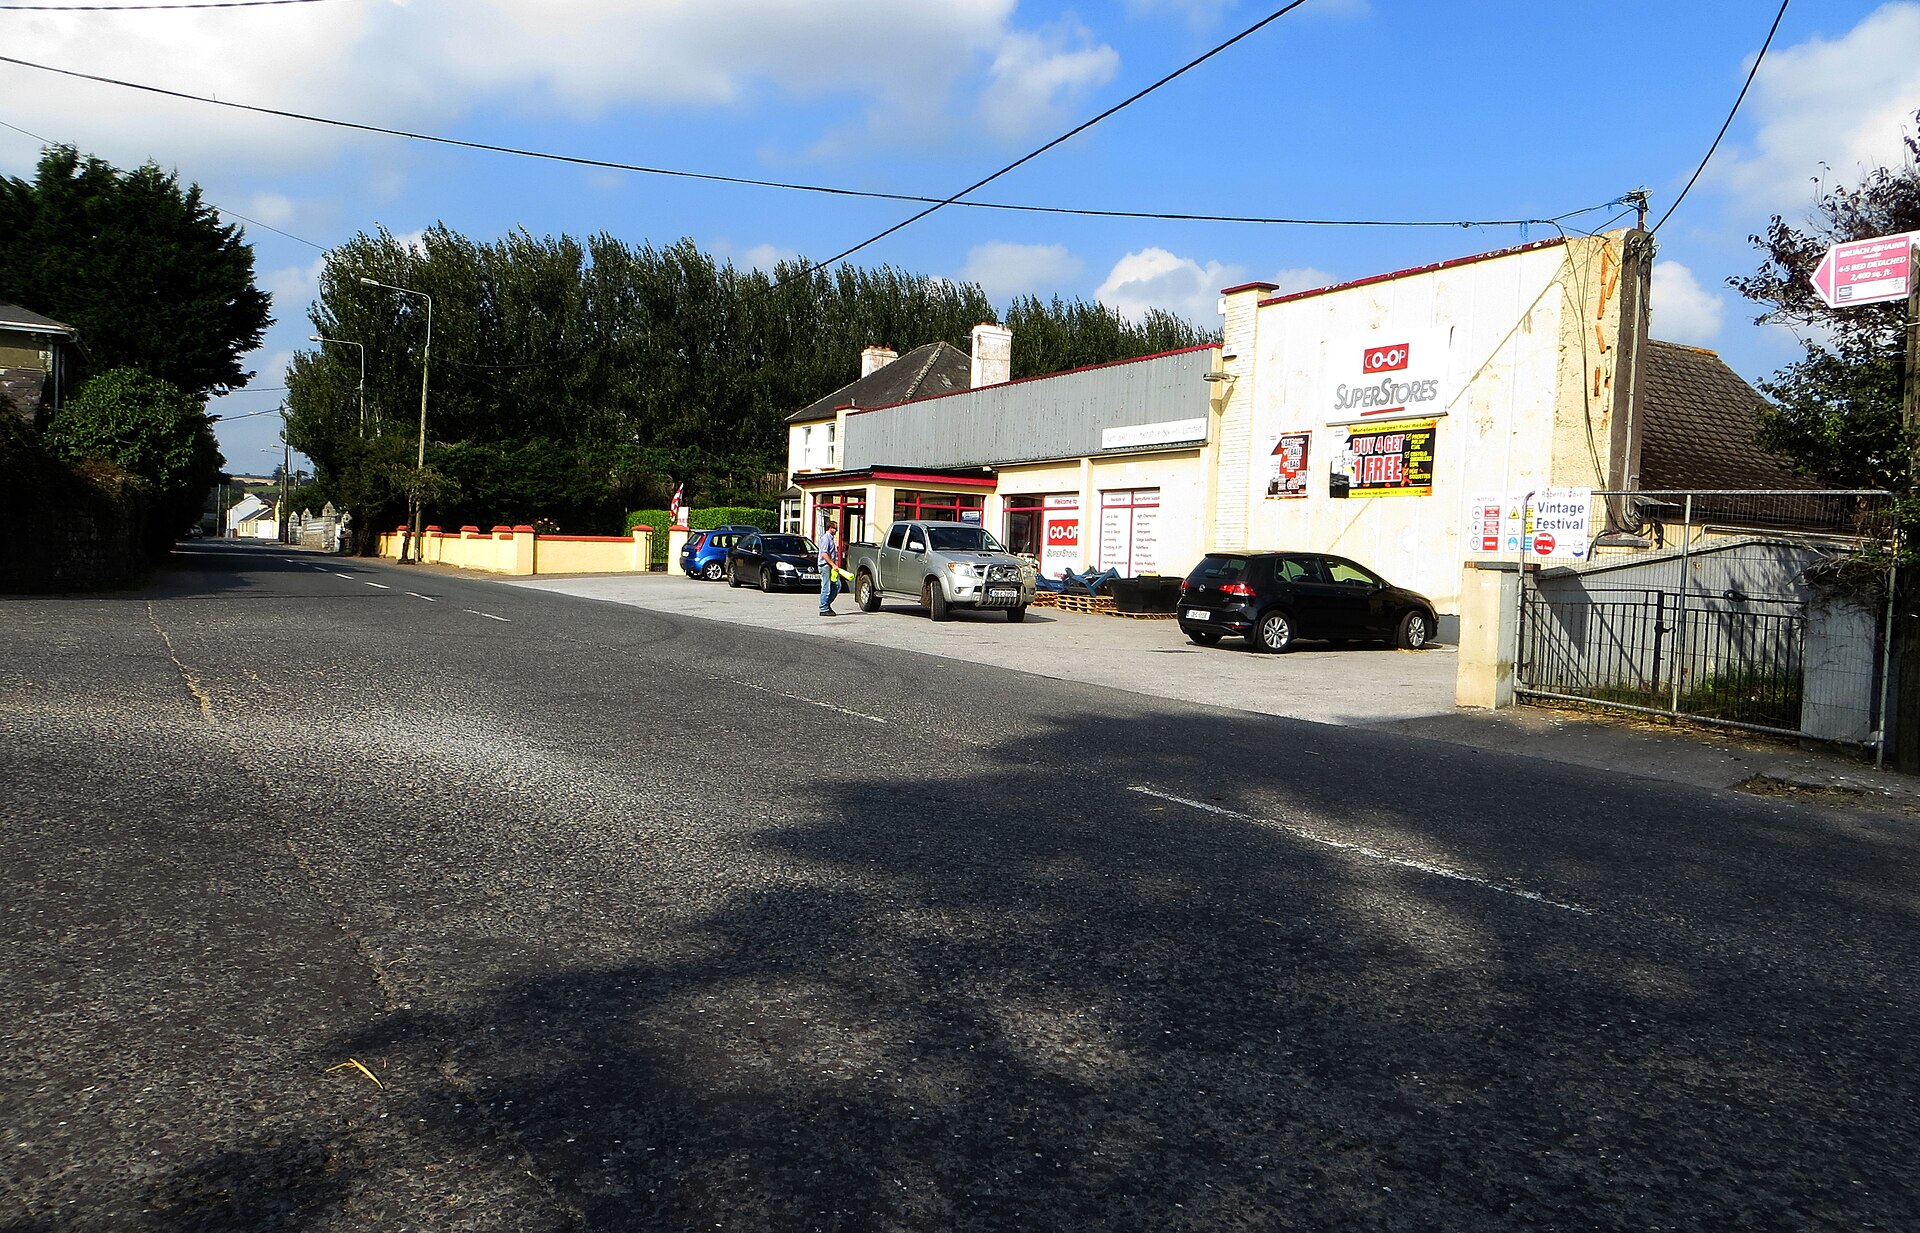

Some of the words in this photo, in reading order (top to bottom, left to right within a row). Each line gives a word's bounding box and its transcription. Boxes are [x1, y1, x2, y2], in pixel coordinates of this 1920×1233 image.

[1867, 256, 1906, 268] DETACHED
[1364, 349, 1406, 369] CO-OP
[1353, 438, 1375, 454] BUY
[1375, 436, 1384, 453] 4
[1384, 435, 1404, 452] GET
[1353, 458, 1362, 482] 1
[1364, 455, 1402, 482] FREE
[1538, 502, 1584, 516] Vintage
[1536, 518, 1584, 530] Festival
[1046, 548, 1078, 558] SUPERSTORE
